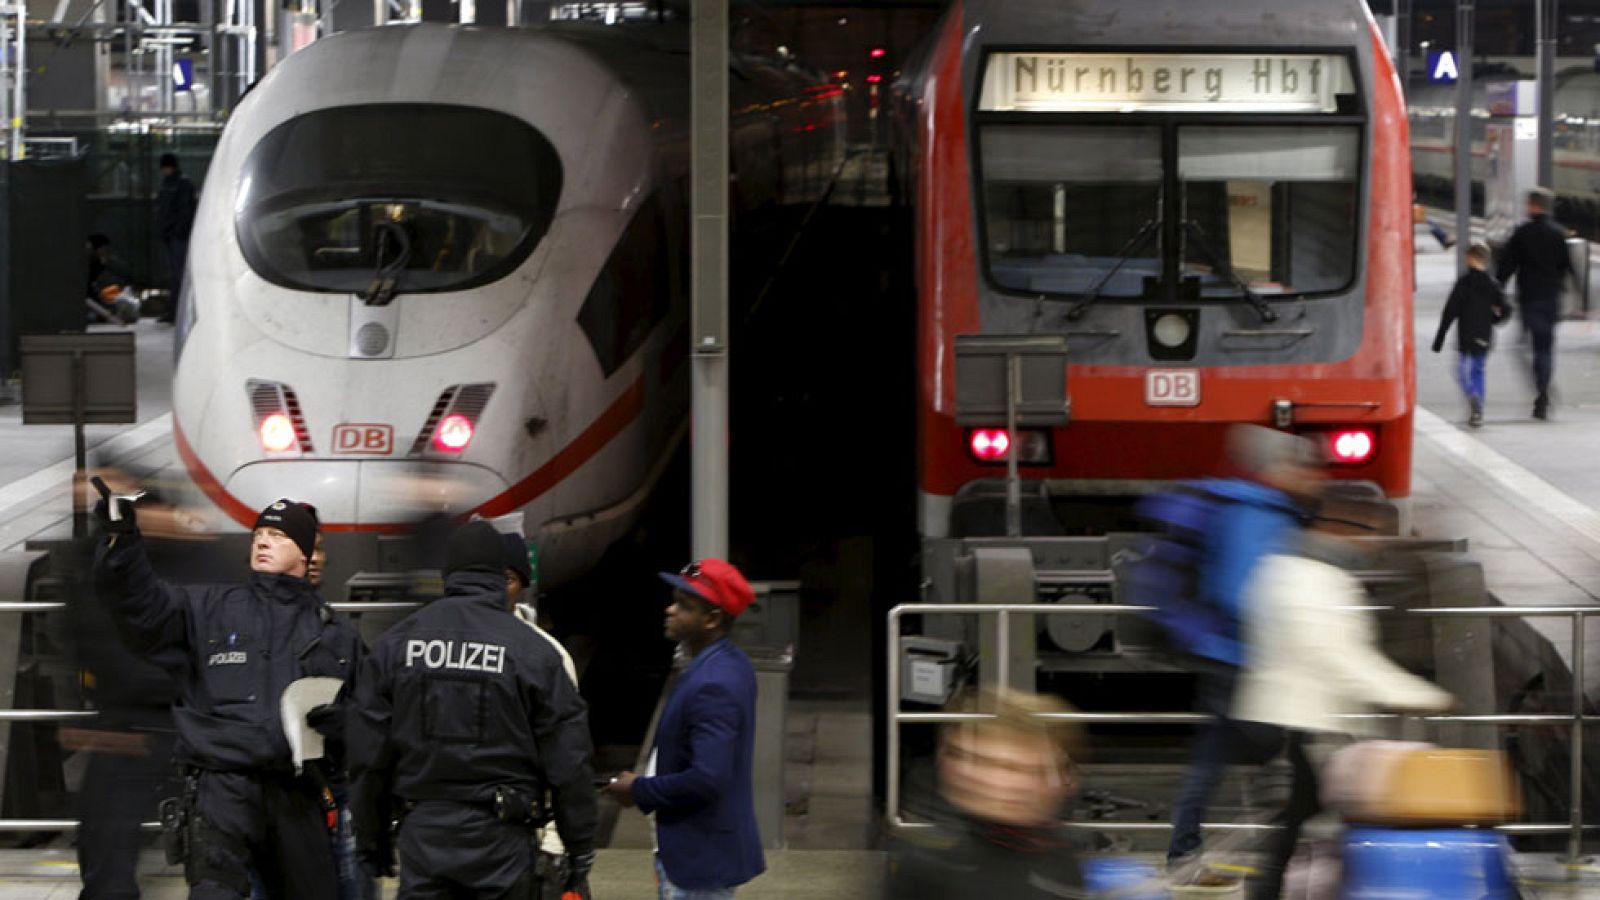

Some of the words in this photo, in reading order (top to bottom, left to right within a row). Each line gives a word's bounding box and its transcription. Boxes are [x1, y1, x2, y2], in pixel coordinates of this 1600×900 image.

[1014, 56, 1223, 102] Nürnberg
[1251, 57, 1322, 94] Hbf
[1434, 51, 1458, 79] A
[1152, 374, 1193, 399] DB
[339, 427, 386, 450] DB
[405, 639, 506, 674] POLIZEI
